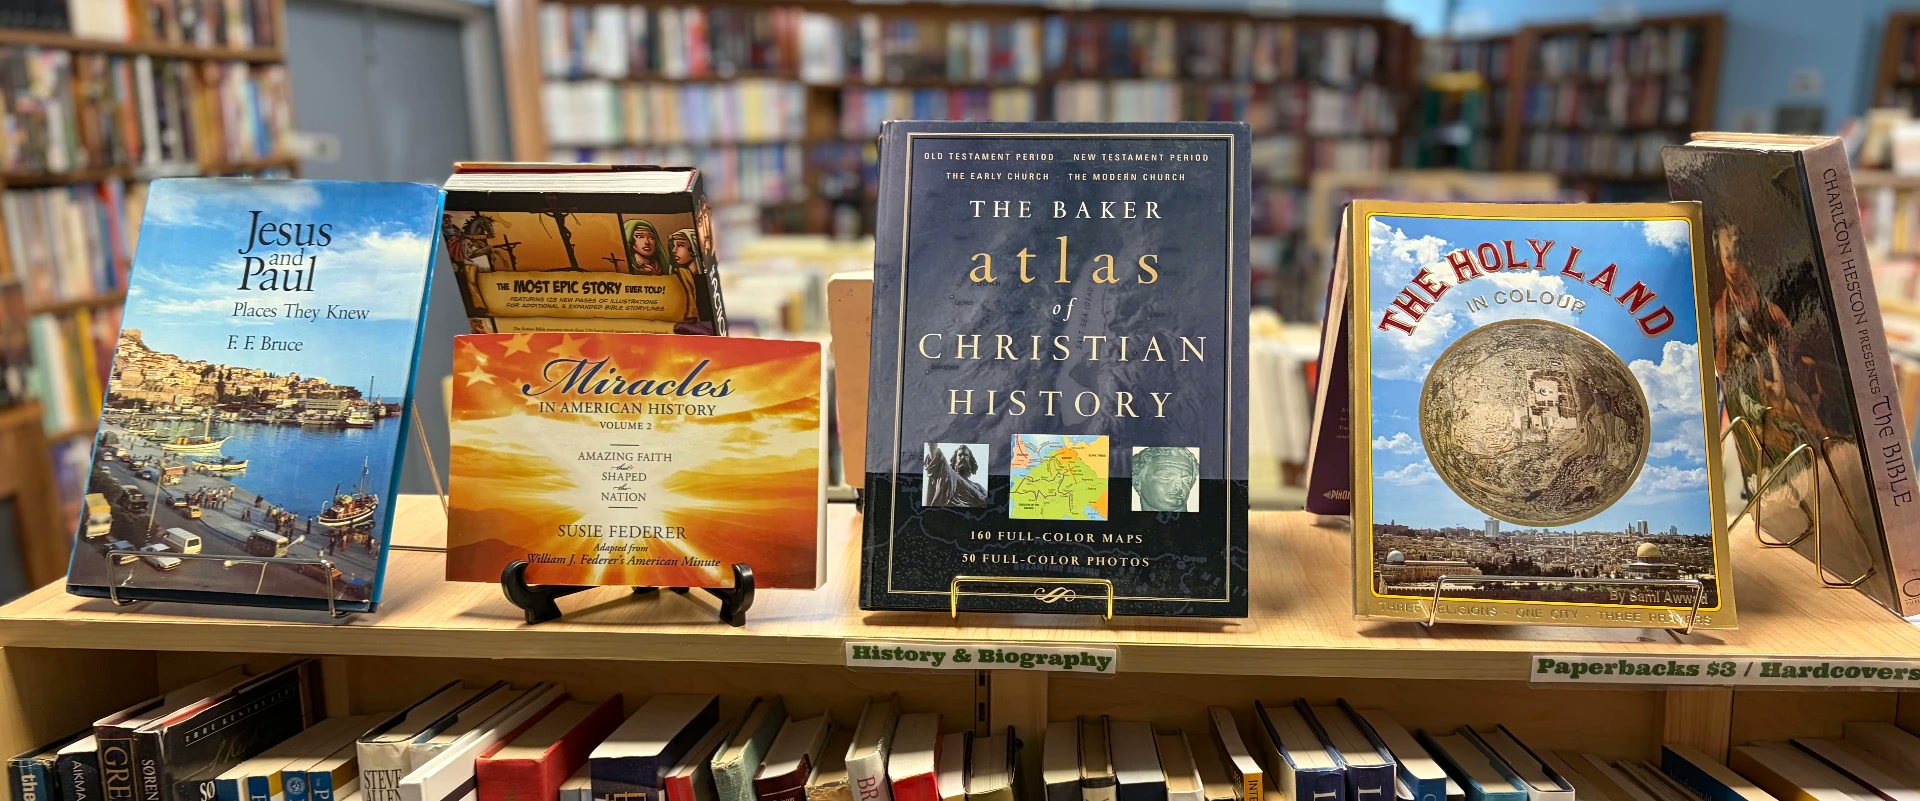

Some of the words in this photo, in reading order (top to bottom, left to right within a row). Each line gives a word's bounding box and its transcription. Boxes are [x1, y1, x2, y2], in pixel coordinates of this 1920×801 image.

[924, 152, 943, 160] OLD
[949, 152, 1011, 161] TESTAMENT
[1016, 153, 1054, 161] PERIOD
[1073, 153, 1096, 161] NEW
[1102, 153, 1164, 161] TESTAMENT
[1170, 153, 1209, 162] PERIOD
[946, 172, 965, 180] THE
[970, 172, 1002, 180] EARLY
[1007, 172, 1049, 181] CHURCH
[1068, 173, 1087, 181] THE
[1093, 173, 1137, 181] MODERN
[1142, 173, 1185, 181] CHURCH
[970, 200, 1032, 218] THE
[1053, 200, 1162, 219] BAKER
[1823, 168, 1852, 255] CHARLTON
[238, 210, 333, 254] Jesus
[269, 248, 304, 266] and
[969, 235, 1160, 284] atlas
[237, 256, 317, 292] Paul
[496, 282, 510, 291] THE
[514, 280, 550, 294] MOST
[553, 280, 579, 294] EPIC
[582, 280, 622, 295] STORY
[625, 285, 643, 294] EVER
[644, 285, 666, 295] TOLD!
[1377, 266, 1453, 337] THE
[1445, 238, 1556, 284] HOLY
[1560, 244, 1676, 338] LAND
[1842, 259, 1868, 325] HESTON
[1052, 297, 1078, 322] of
[1466, 294, 1488, 314] IN
[1493, 288, 1588, 315] COLOUR
[232, 301, 278, 318] Places
[284, 302, 321, 323] They
[326, 304, 370, 320] Knew
[227, 335, 238, 350] F.
[244, 335, 256, 351] F.
[261, 336, 303, 351] Bruce
[918, 333, 1207, 363] CHRISTIAN
[1858, 329, 1881, 395] PRESENTS
[522, 355, 736, 398] Miracles
[539, 402, 557, 414] IN
[560, 402, 644, 415] AMERICAN
[648, 403, 717, 417] HISTORY
[948, 388, 1173, 418] HISTORY
[599, 421, 644, 431] VOLUME
[647, 422, 652, 431] 2
[1872, 395, 1895, 438] The
[578, 451, 634, 462] AMAZING
[637, 452, 673, 463] FAITH
[601, 472, 647, 482] SHAPED
[1882, 441, 1912, 507] BIBLE
[601, 492, 647, 502] NATION
[557, 524, 603, 538] SUSIE
[608, 525, 687, 540] FEDERER
[970, 530, 992, 540] 160
[997, 531, 1096, 543] FULL-COLOR
[1102, 533, 1143, 544] MAPS
[593, 543, 627, 553] Adapted
[627, 543, 648, 554] from
[527, 553, 566, 564] William
[567, 554, 576, 567] J.
[580, 554, 625, 566] Federer's
[627, 555, 678, 567] American
[682, 556, 721, 567] Minute
[962, 553, 976, 563] 50
[982, 553, 1080, 566] FULL-COLOR
[1087, 556, 1150, 567] PHOTOS
[1610, 590, 1626, 605] By
[1378, 602, 1423, 613] THREE
[1516, 608, 1543, 618] ONE
[1551, 609, 1579, 620] CITY
[1597, 611, 1641, 623] THREE
[852, 644, 946, 667] History
[952, 647, 972, 664] &
[977, 648, 1112, 672] Biography
[1536, 658, 1700, 680] Paperbacks
[1706, 660, 1738, 679] $3
[1759, 662, 1920, 681] Hardcovers
